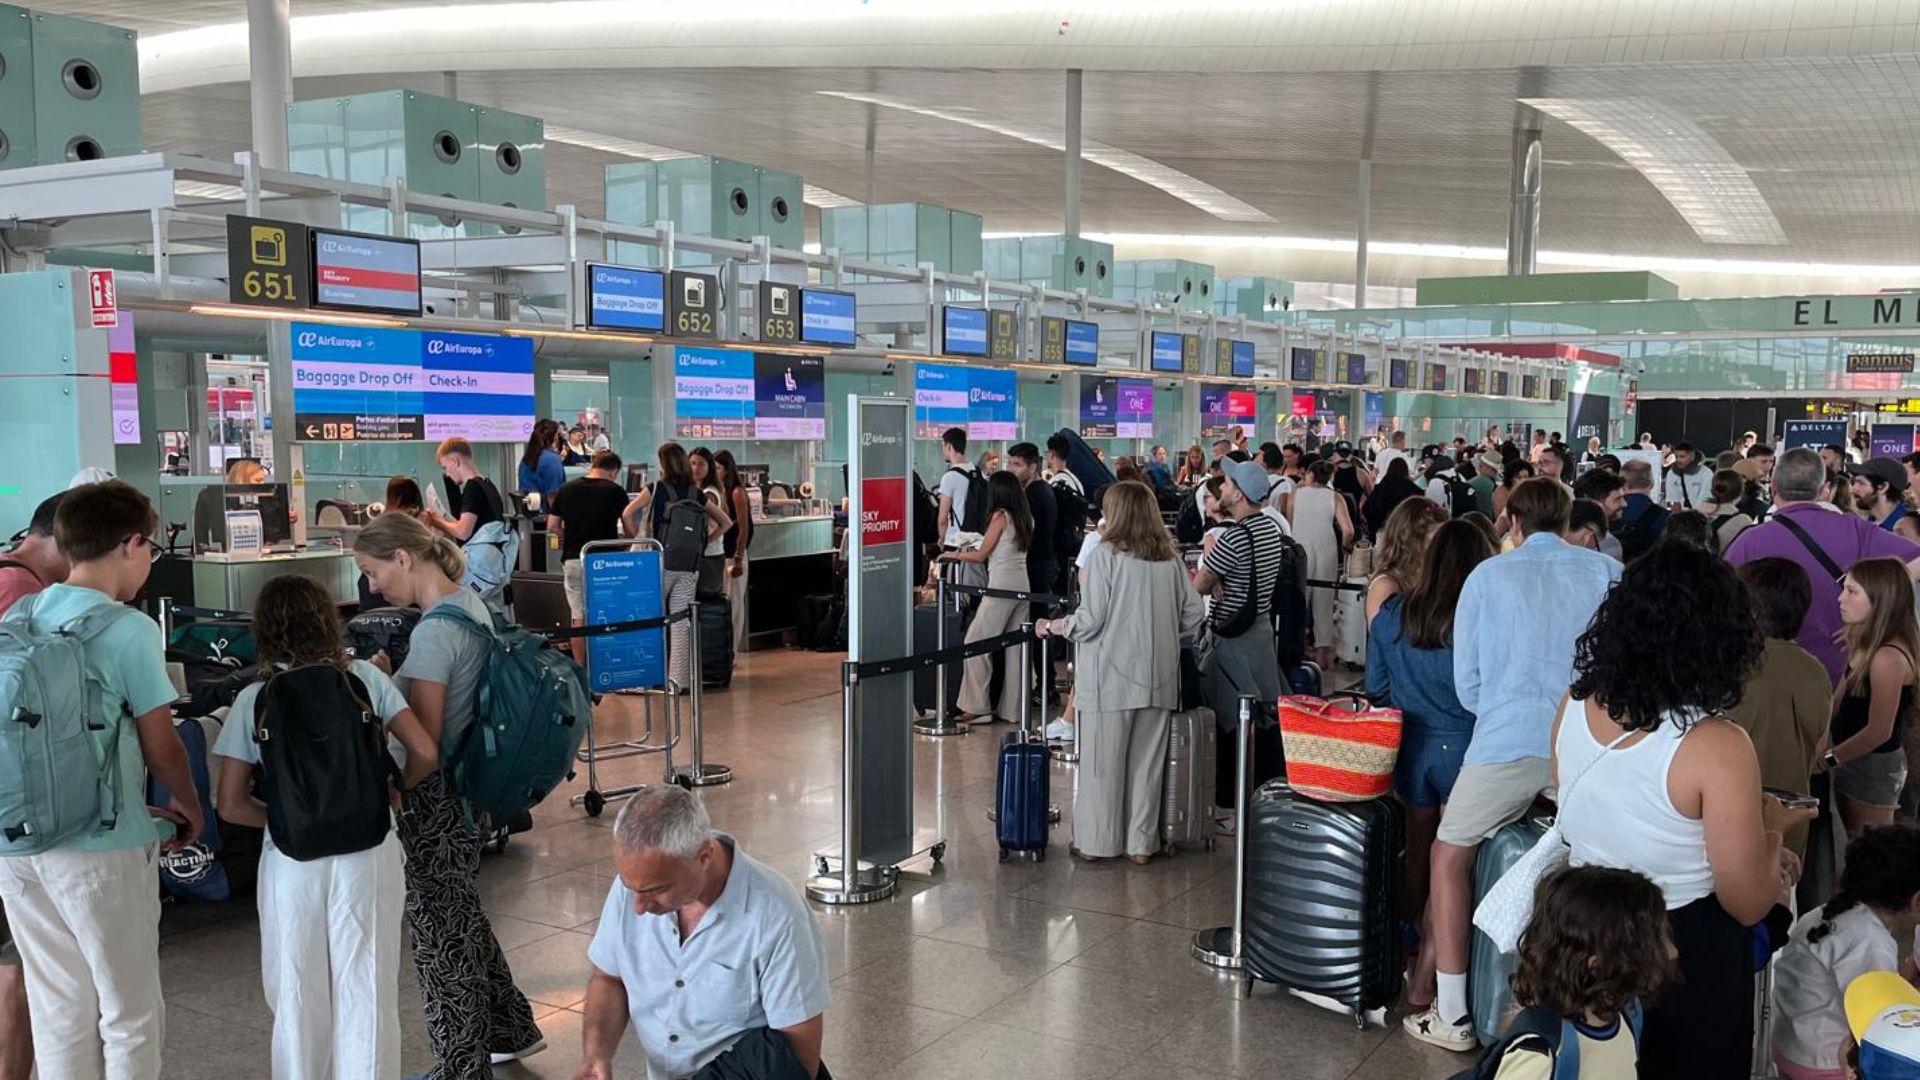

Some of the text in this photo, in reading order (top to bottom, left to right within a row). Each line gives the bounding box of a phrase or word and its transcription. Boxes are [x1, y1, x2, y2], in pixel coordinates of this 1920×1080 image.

[243, 271, 297, 300] 651
[629, 299, 645, 309] Drop
[646, 300, 658, 309] Off
[1794, 300, 1838, 325] EL
[679, 312, 711, 333] 652
[766, 318, 794, 339] 653
[318, 334, 362, 348] AirEuropa
[994, 339, 1015, 356] 654
[444, 343, 482, 355] AirEuropa
[1044, 344, 1062, 360] 655
[1849, 355, 1913, 368] pannus
[296, 368, 414, 386] Bagagge Drop Off
[715, 384, 734, 396] Drop
[736, 384, 748, 394] Off
[775, 394, 806, 403] MAIN CABIN
[1129, 397, 1144, 410] ONE
[1581, 424, 1596, 437] DELTA
[872, 434, 896, 444] AirEuropa
[1882, 444, 1908, 453] ONE
[862, 510, 879, 522] SKY
[862, 519, 900, 533] PRIORITY
